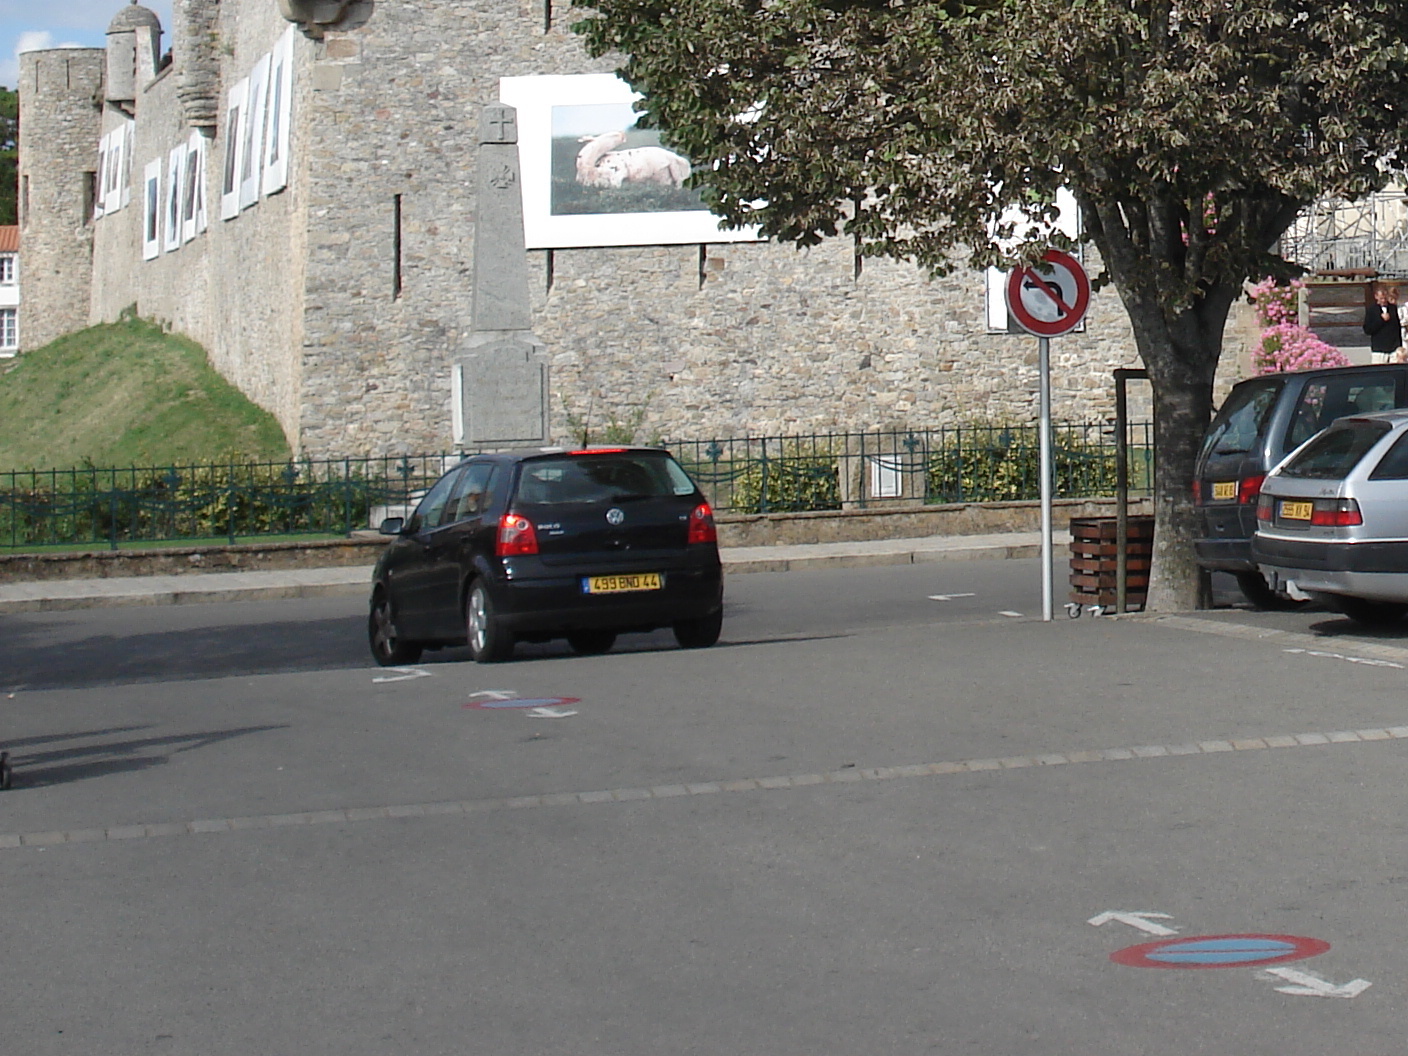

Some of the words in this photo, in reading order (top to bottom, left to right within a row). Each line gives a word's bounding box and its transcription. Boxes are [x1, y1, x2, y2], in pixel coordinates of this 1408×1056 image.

[594, 577, 617, 590] 499
[619, 576, 640, 589] BND
[643, 575, 658, 587] 44
